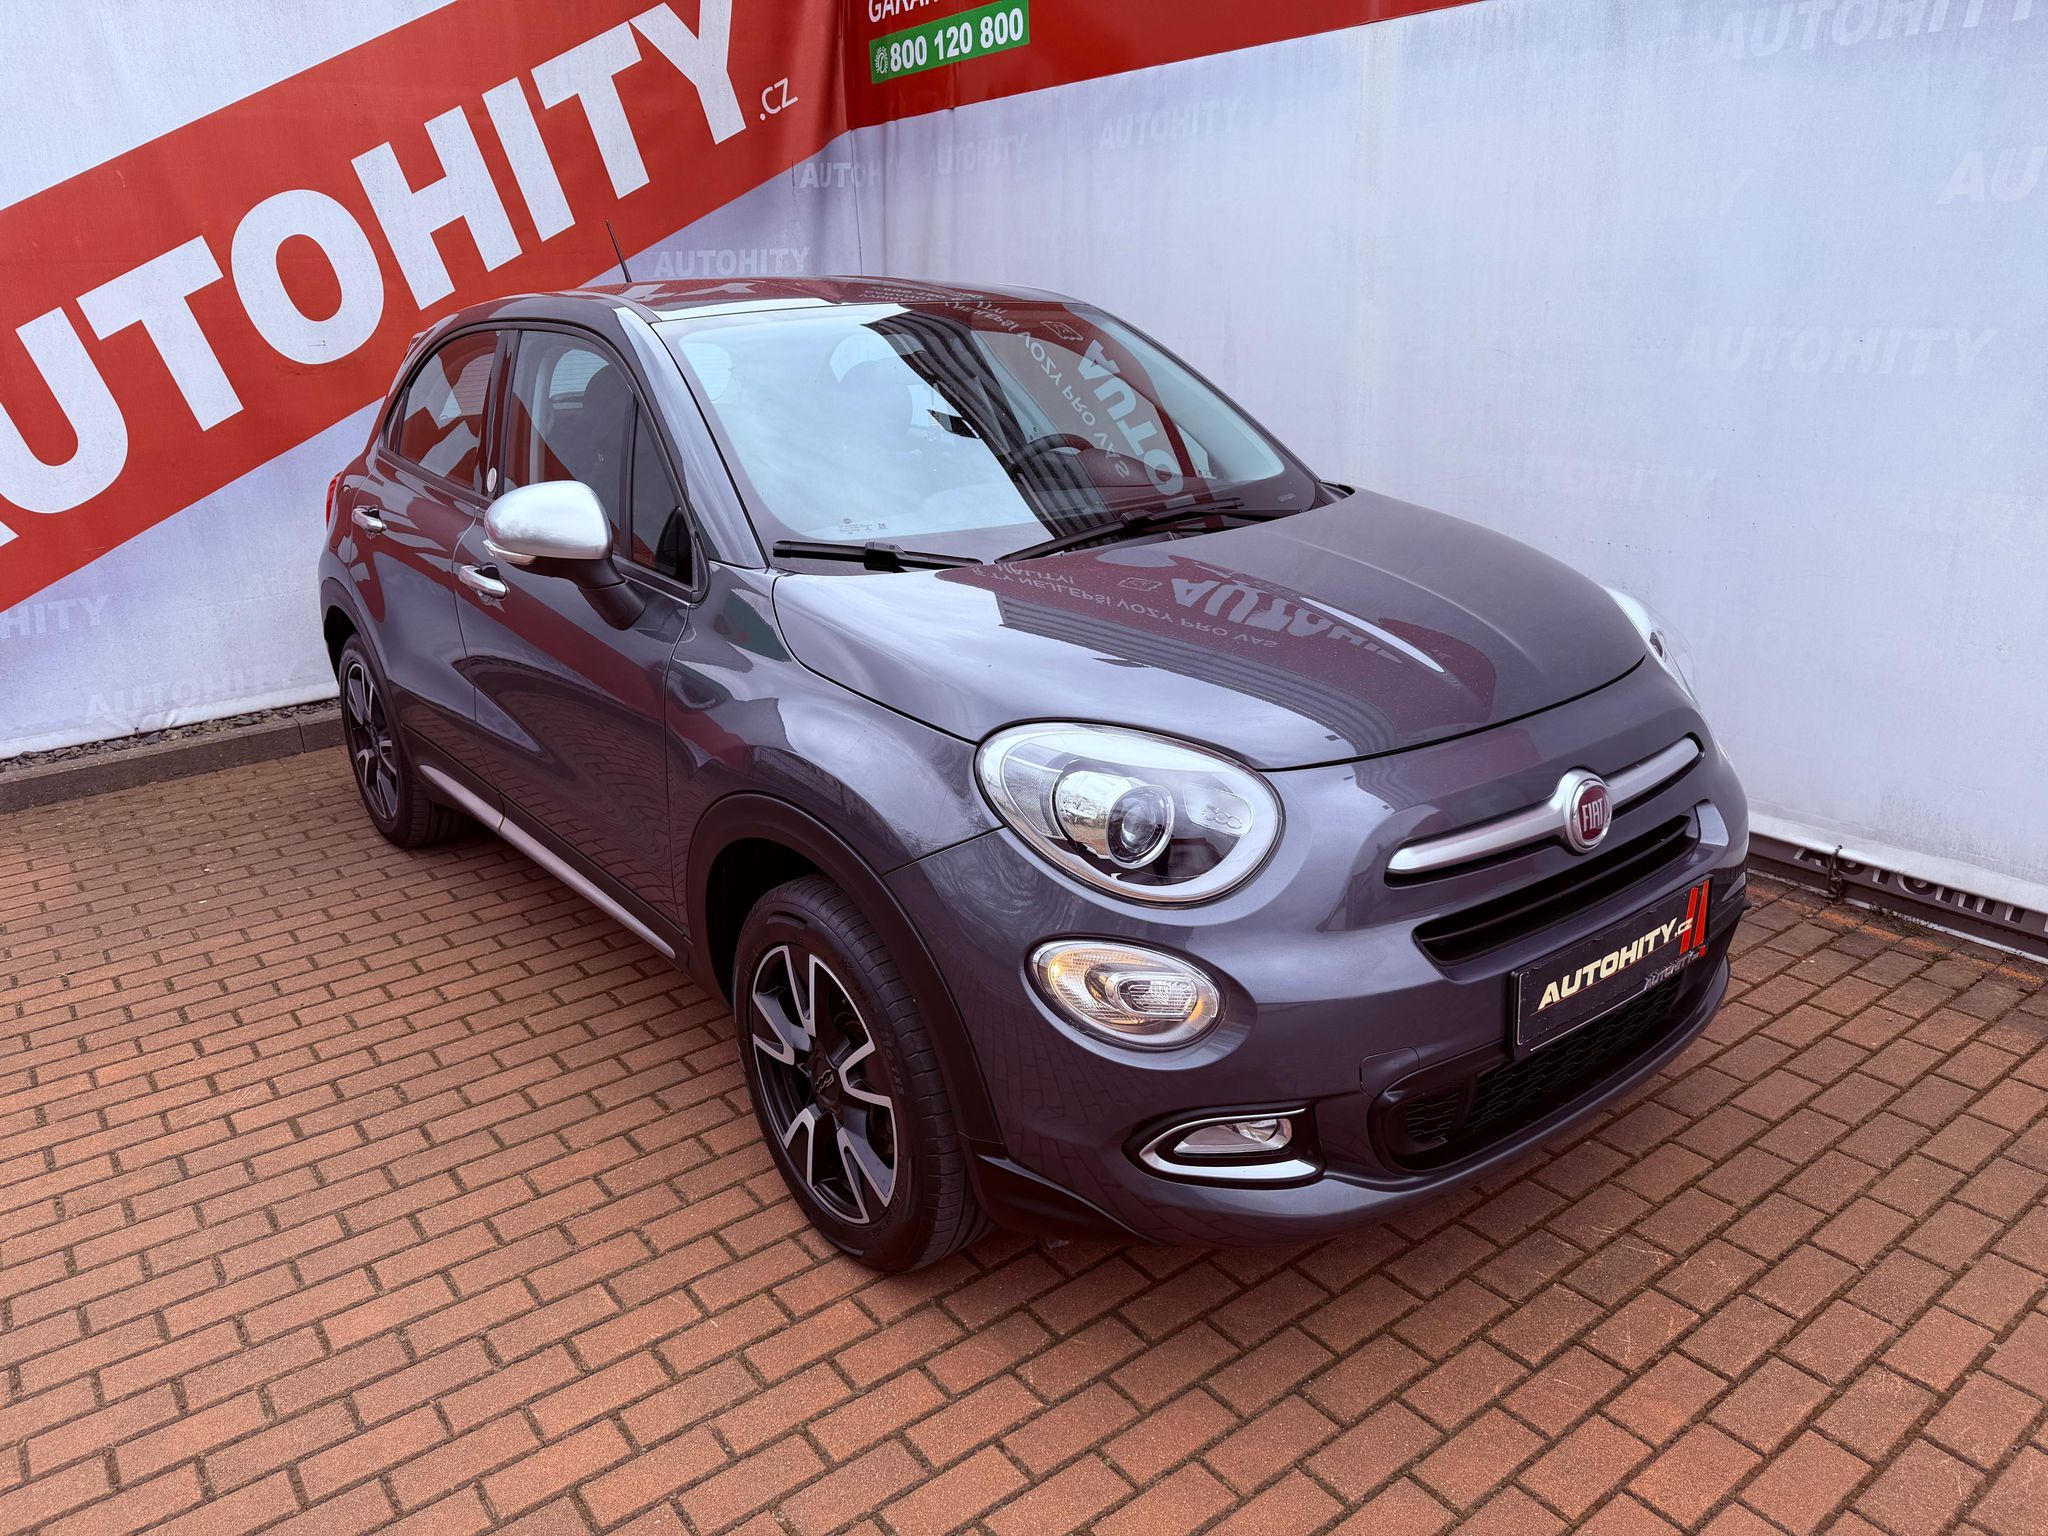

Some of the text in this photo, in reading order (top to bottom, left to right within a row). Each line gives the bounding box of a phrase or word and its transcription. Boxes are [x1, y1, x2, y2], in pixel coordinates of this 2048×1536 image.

[890, 8, 1024, 72] 800 120 800
[655, 247, 811, 277] AUTOHITY
[1676, 326, 2000, 377] AUTOHITY
[1581, 797, 1603, 833] FIAT
